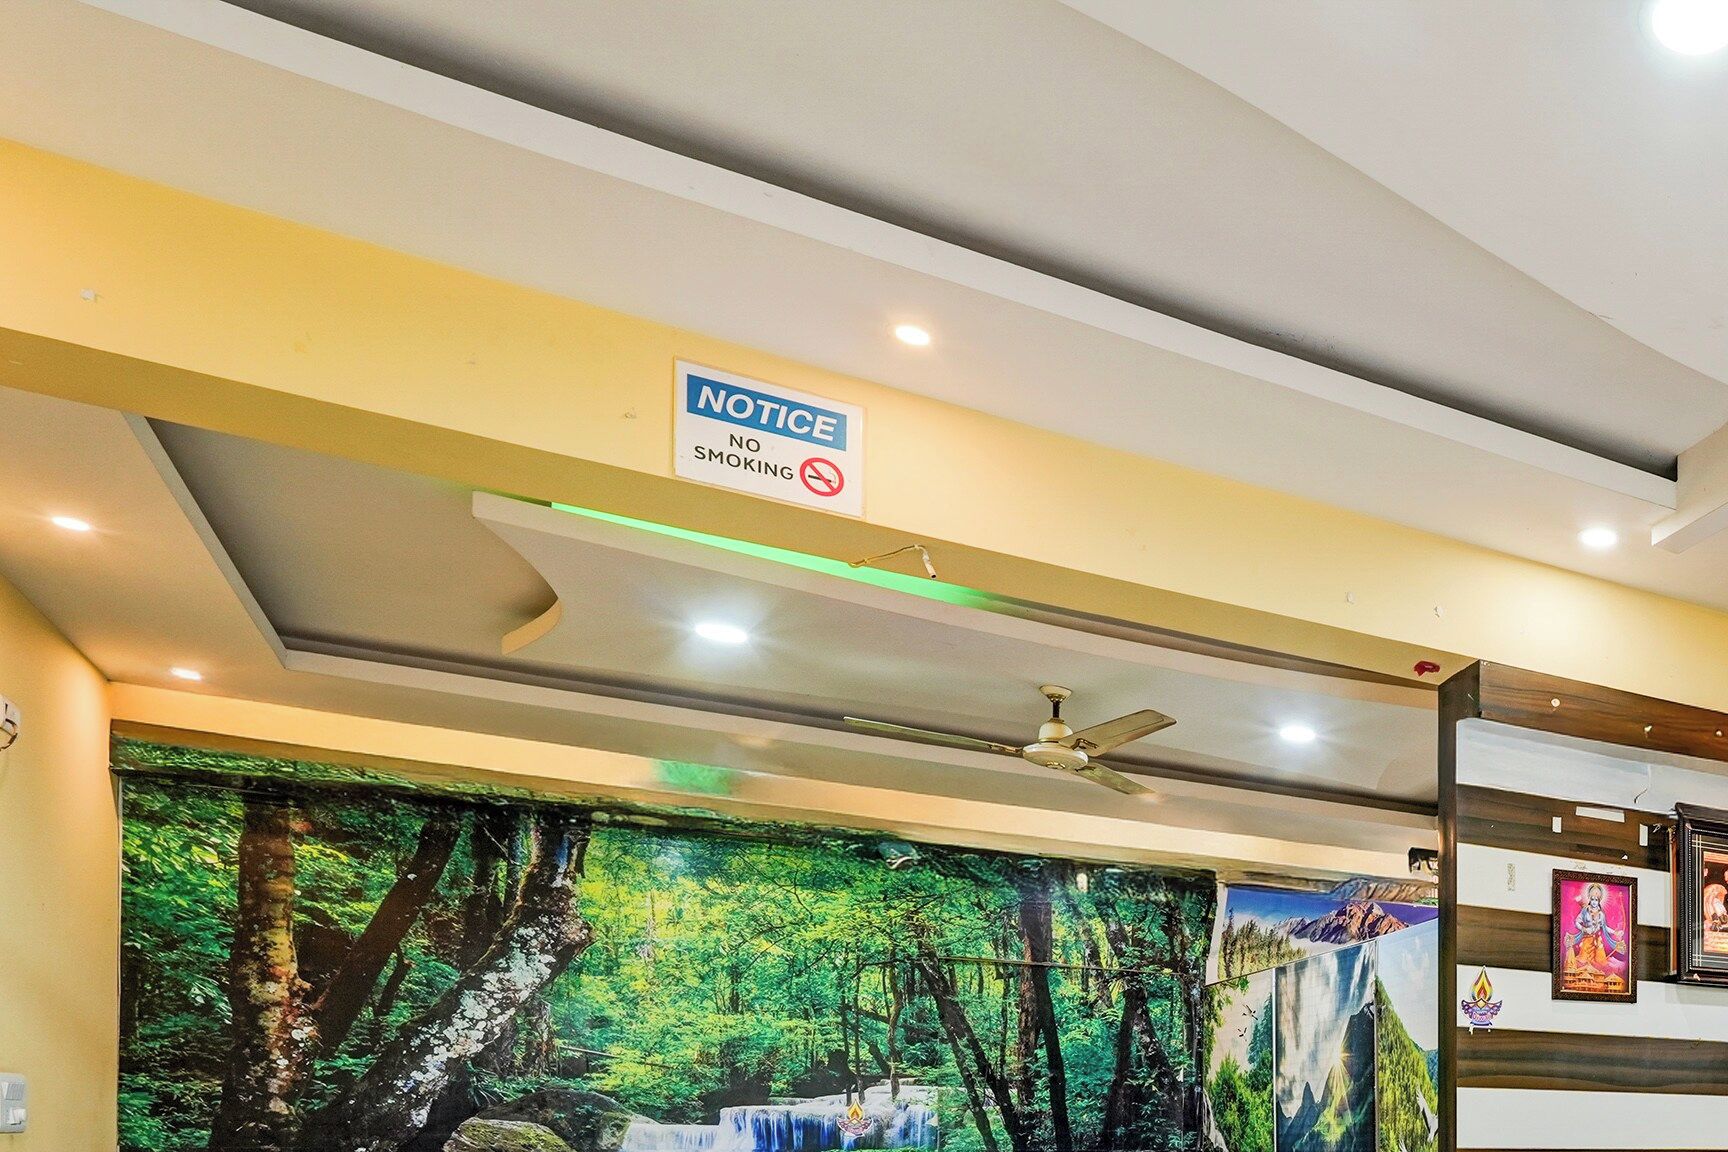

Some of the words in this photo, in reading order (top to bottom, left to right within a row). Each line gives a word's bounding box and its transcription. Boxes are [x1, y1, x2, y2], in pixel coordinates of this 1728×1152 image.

[697, 385, 837, 442] NOTICE
[729, 433, 761, 453] NO
[694, 445, 794, 481] SMOKING
